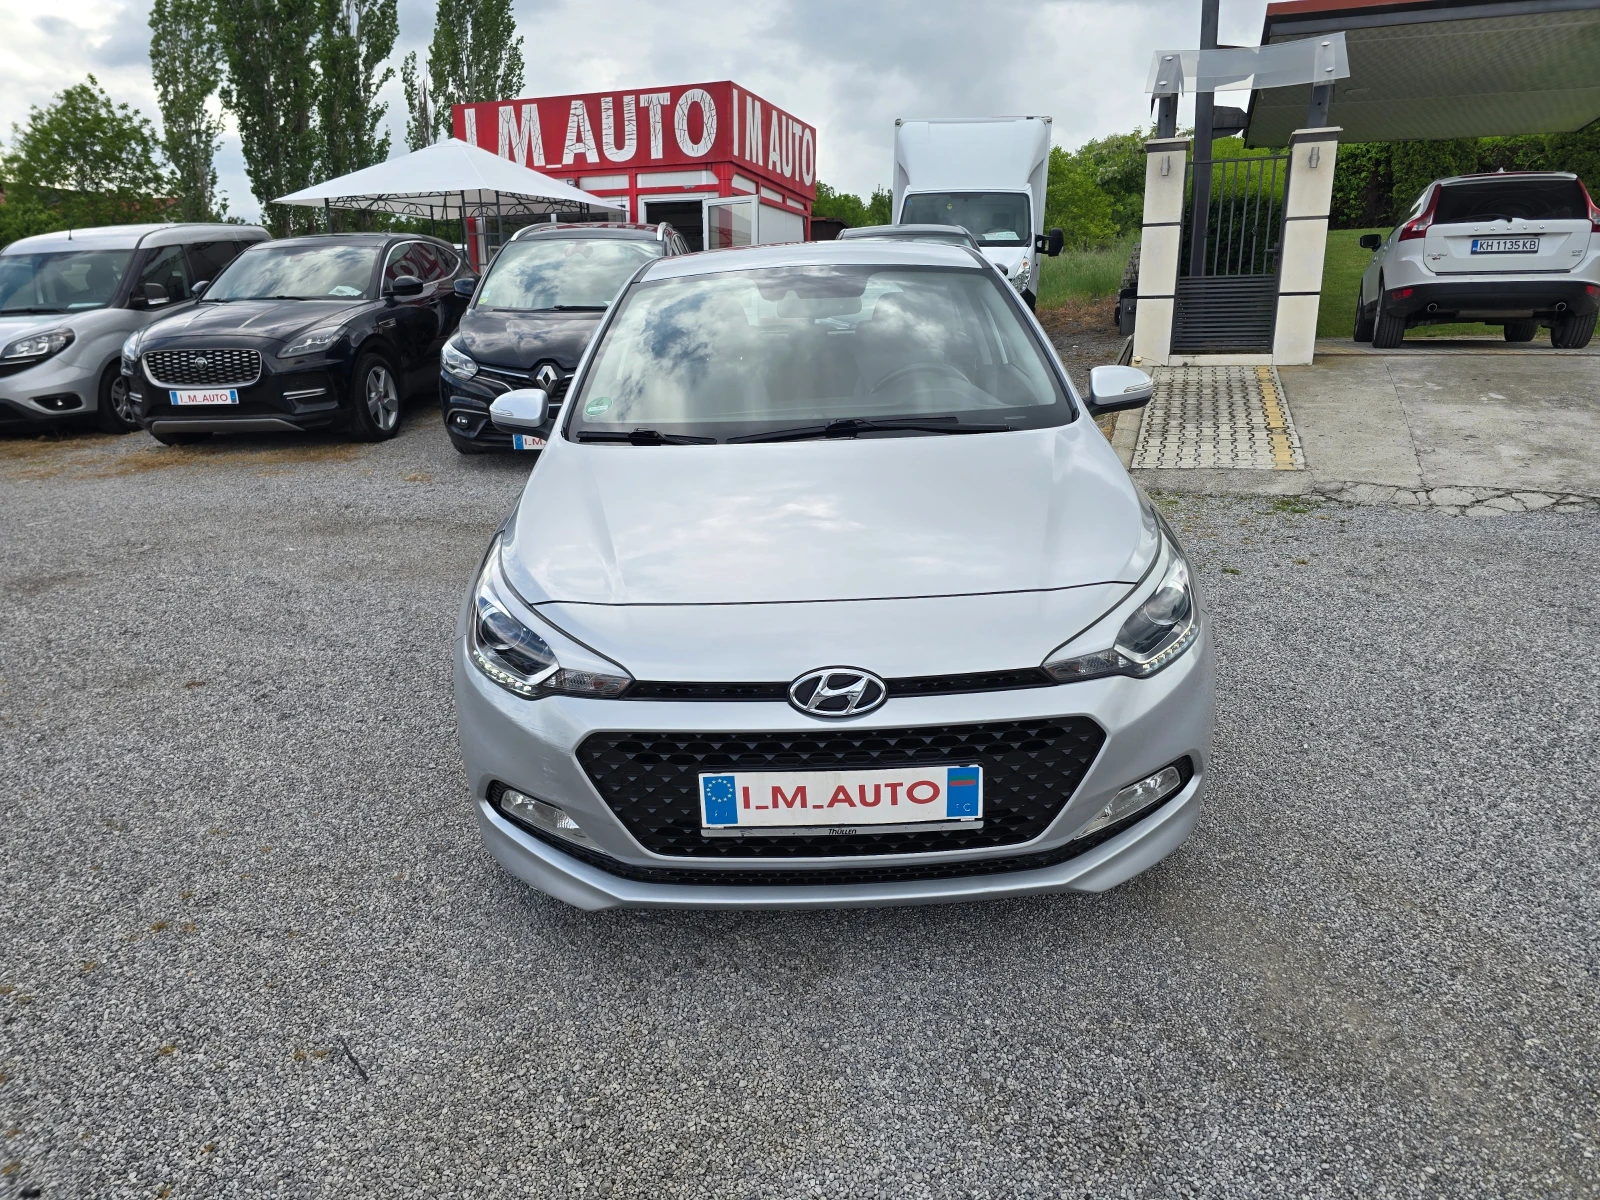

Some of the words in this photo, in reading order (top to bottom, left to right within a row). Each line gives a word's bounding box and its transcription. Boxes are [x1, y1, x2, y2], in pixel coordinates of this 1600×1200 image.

[768, 110, 814, 187] AUTO
[179, 394, 228, 403] I_M_AUTO
[742, 780, 940, 810] I_M_AUTO
